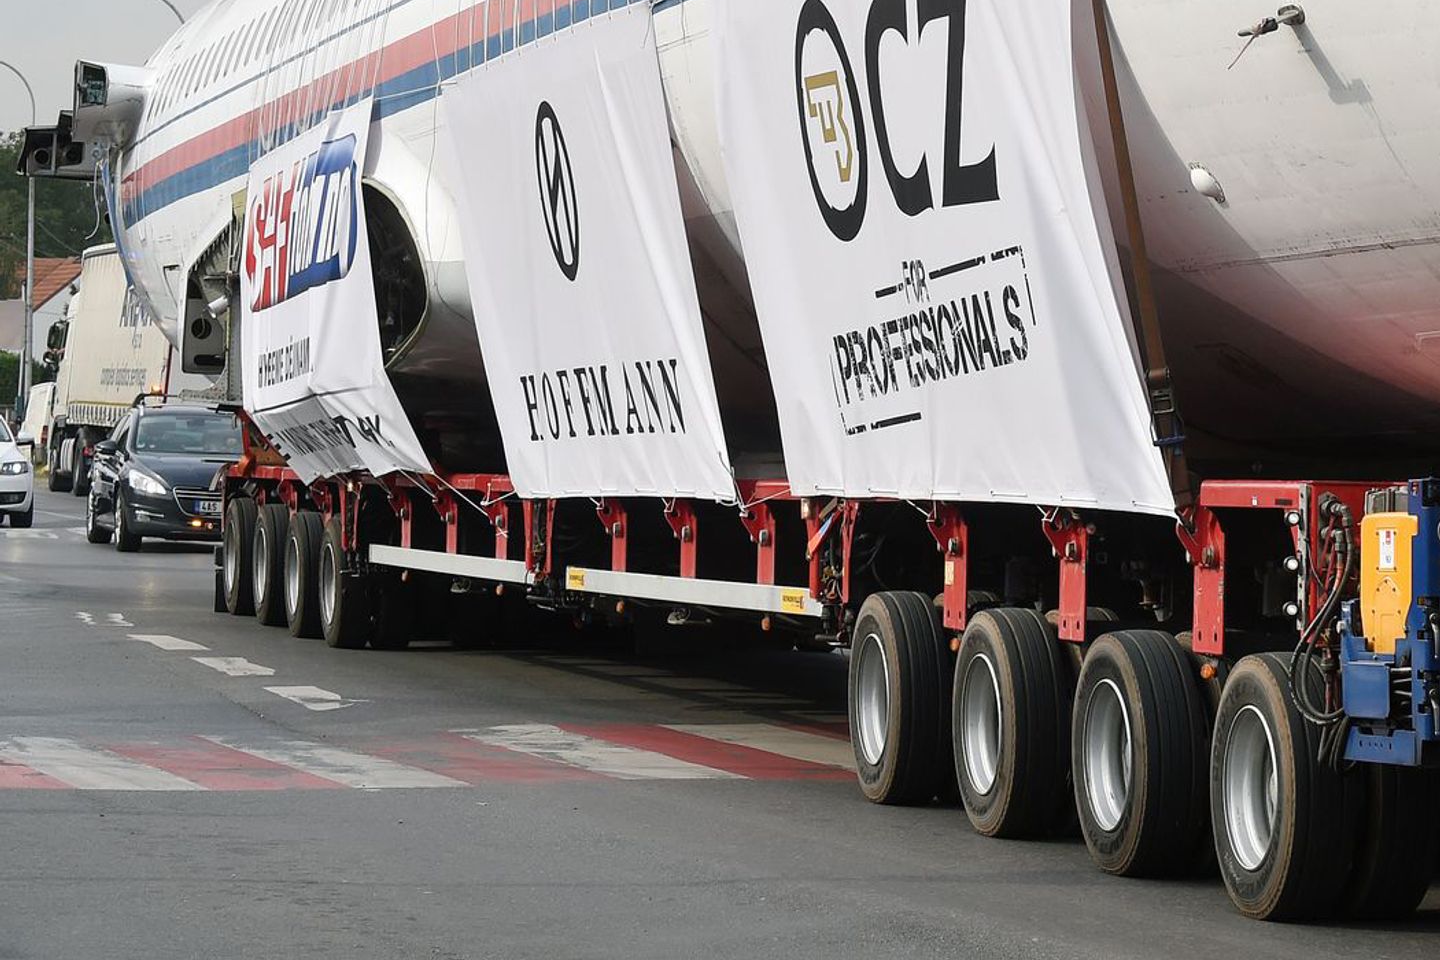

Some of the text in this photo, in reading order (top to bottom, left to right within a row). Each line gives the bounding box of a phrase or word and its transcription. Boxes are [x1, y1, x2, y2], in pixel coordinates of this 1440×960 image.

[902, 259, 930, 304] FOR
[833, 285, 1029, 405] PROFESSIONALS
[520, 359, 686, 441] HOFFMANN
